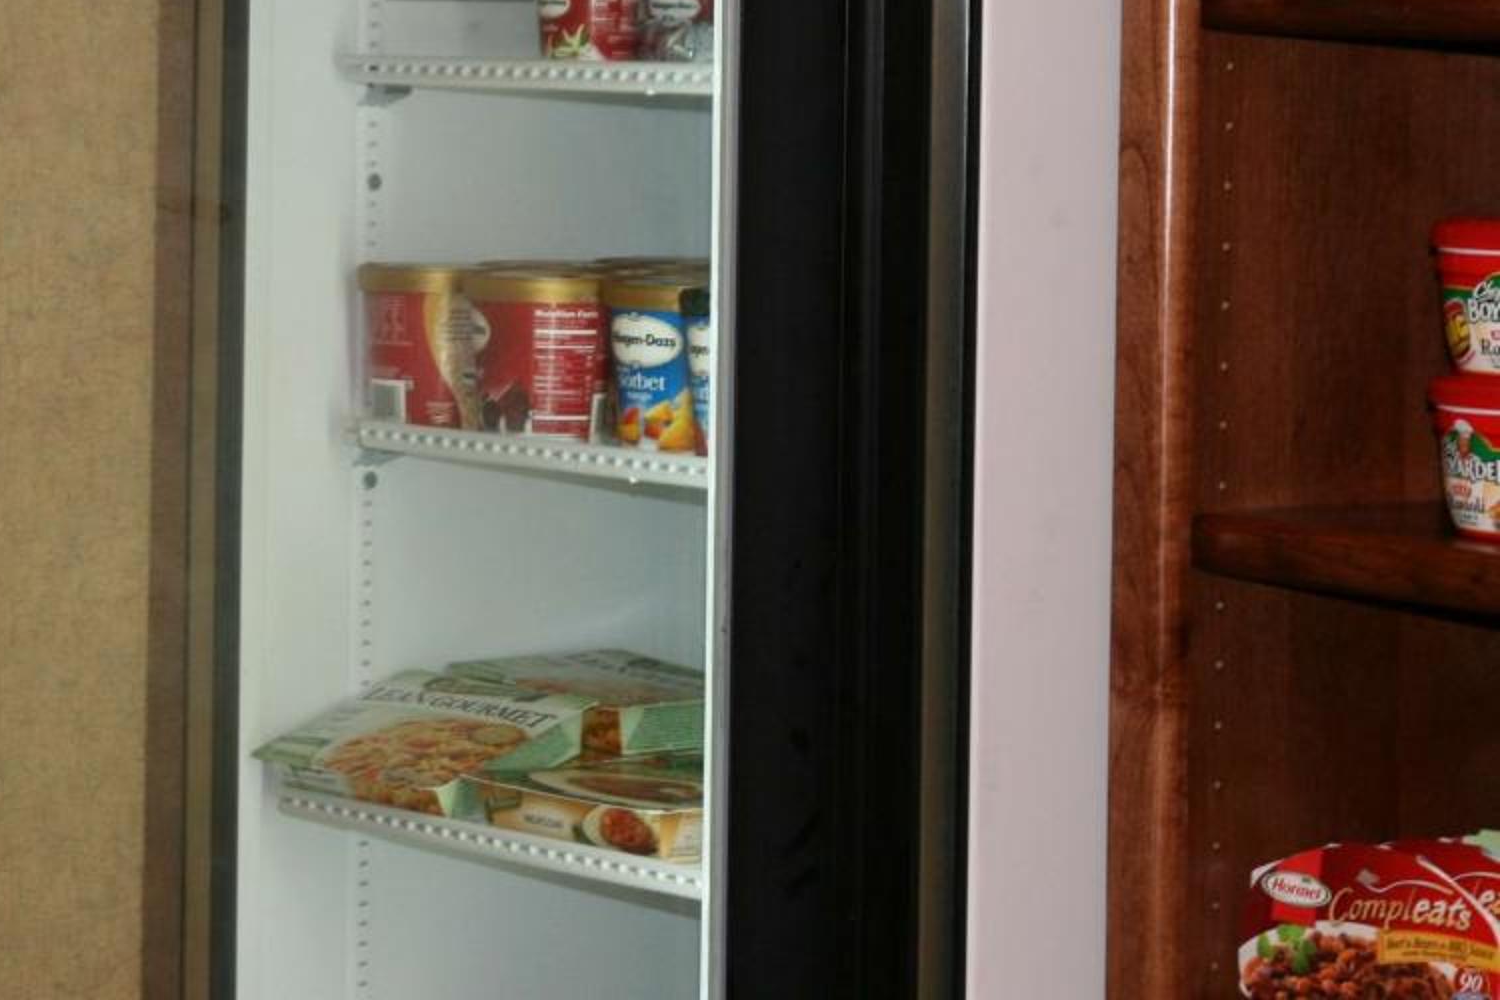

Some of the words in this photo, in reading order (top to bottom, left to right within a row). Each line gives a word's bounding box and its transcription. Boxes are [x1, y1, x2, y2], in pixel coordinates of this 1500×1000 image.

[1271, 876, 1323, 900] Hormel
[1329, 886, 1472, 932] Compleats
[1459, 972, 1484, 993] 90
